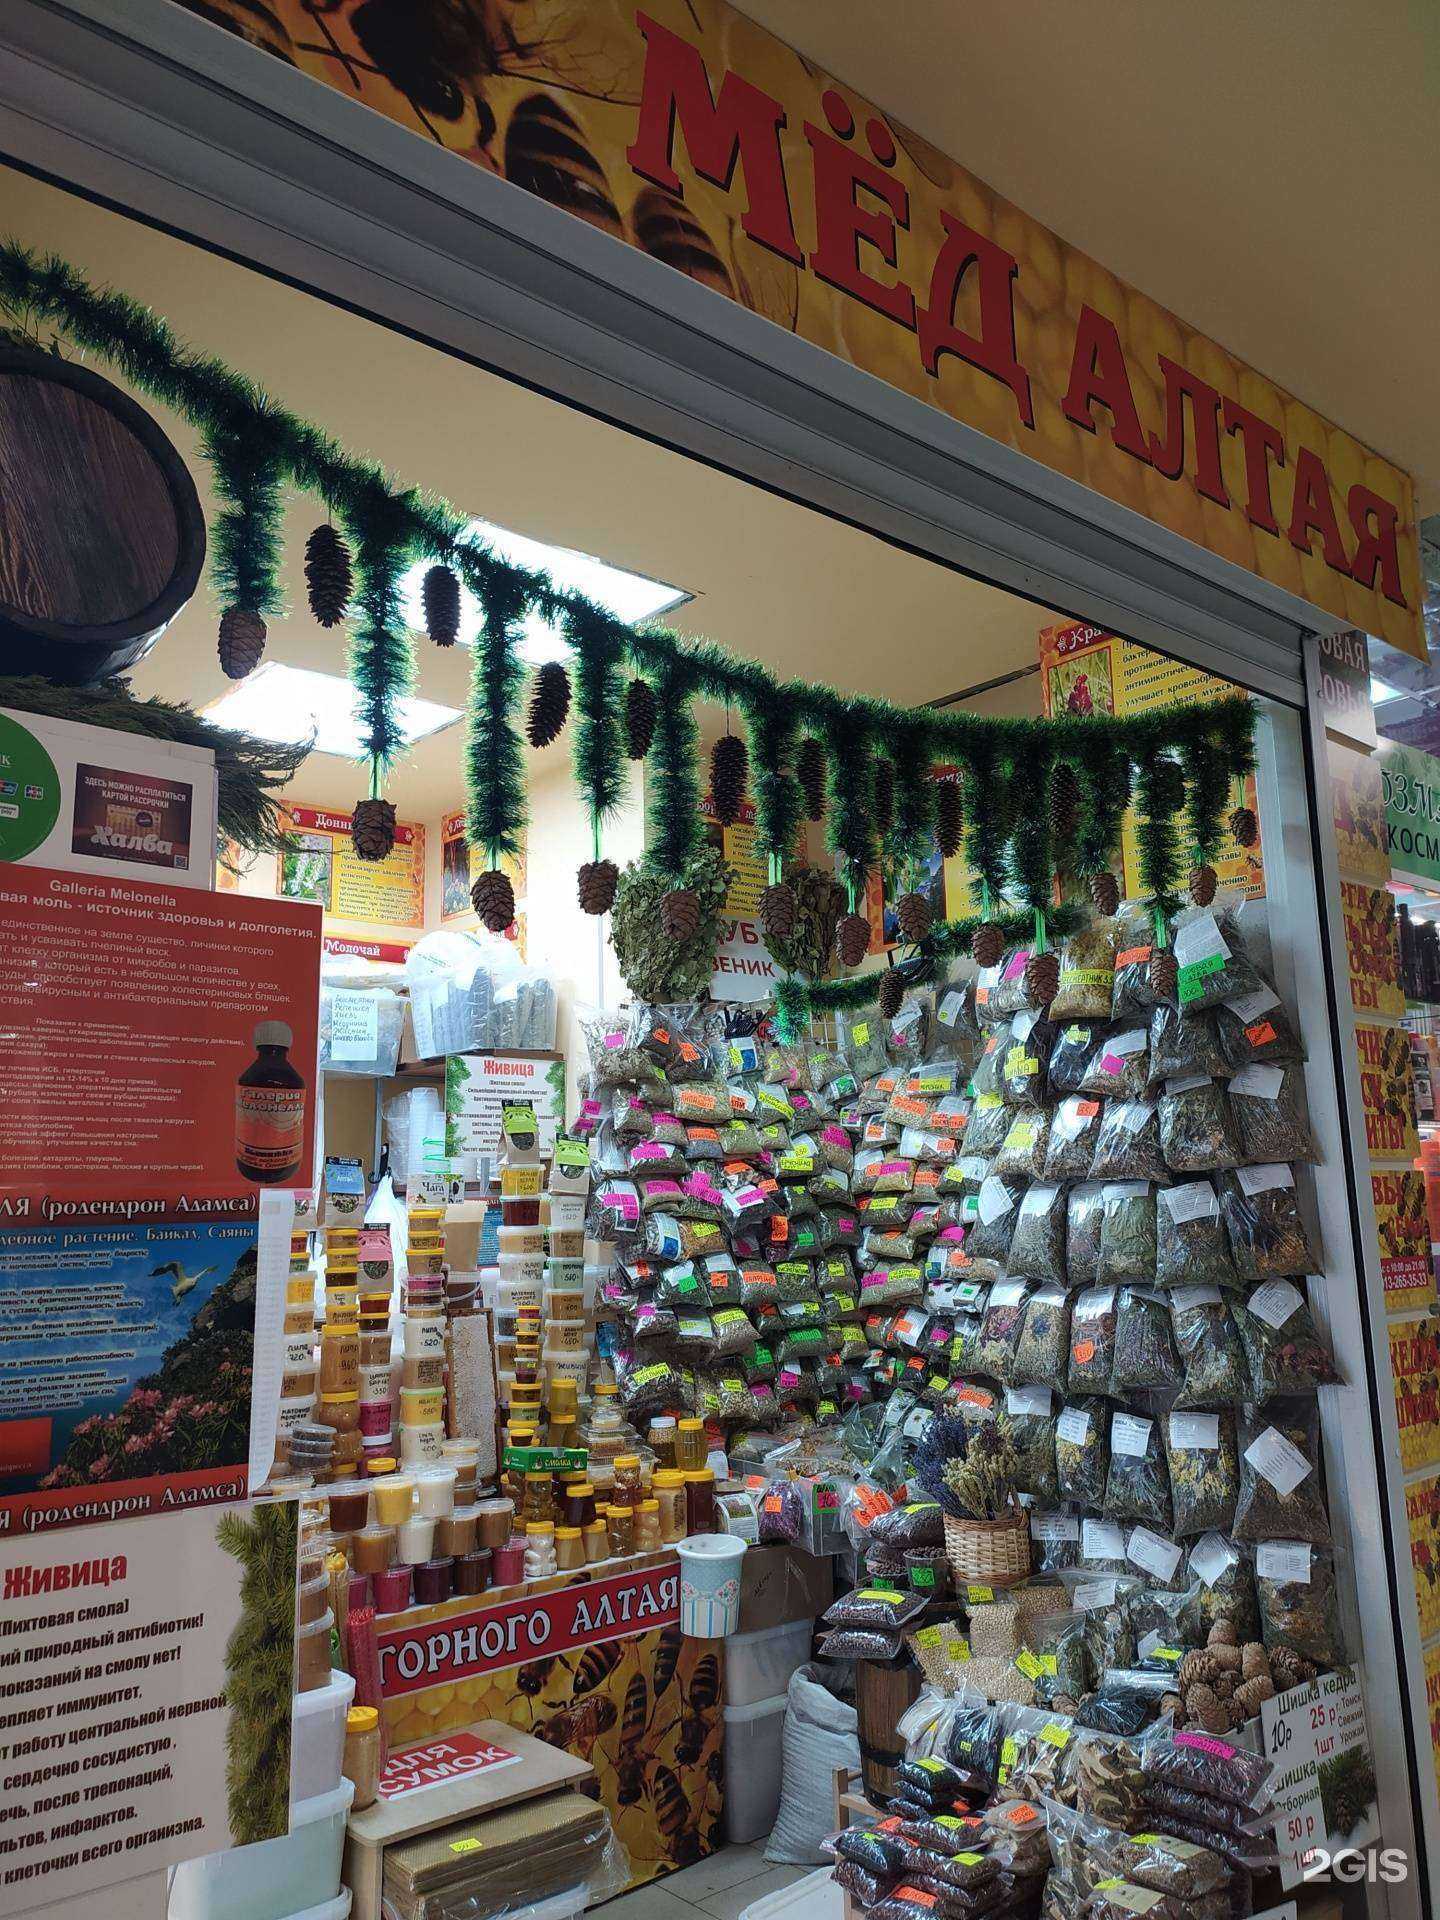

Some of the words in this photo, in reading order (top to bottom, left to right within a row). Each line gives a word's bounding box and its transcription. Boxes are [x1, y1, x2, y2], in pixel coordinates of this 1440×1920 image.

[626, 9, 1035, 430] МЁД
[1061, 304, 1407, 608] АЛТАЯ
[1069, 625, 1105, 650] Кра
[84, 777, 106, 787] ЗДЕСЬ
[108, 780, 134, 792] МОЖНО
[102, 790, 128, 801] КАРТОЙ
[91, 825, 173, 855] Халва
[49, 880, 106, 898] Galleria
[110, 887, 176, 907] Melonella
[32, 895, 72, 910] моль
[87, 903, 155, 920] источник
[157, 911, 224, 929] здоровья
[228, 919, 236, 928] и
[239, 921, 316, 939] долголетия.
[2, 920, 81, 936] единственное
[100, 931, 133, 941] земле
[136, 934, 188, 949] существо,
[190, 939, 230, 951] личинки
[232, 944, 274, 957] которого
[32, 936, 88, 948] усваивать
[91, 941, 144, 954] пчелиный
[326, 940, 380, 957] Молочай
[12, 946, 48, 958] клетку
[52, 949, 109, 963] организма
[112, 956, 124, 964] от
[127, 957, 176, 969] микробов
[33, 972, 107, 987] способствует
[110, 979, 168, 992] появлению
[172, 984, 252, 1000] холестериновых
[44, 961, 91, 974] который
[94, 966, 118, 976] есть
[121, 968, 127, 976] в
[130, 969, 189, 982] небольшом
[193, 975, 247, 988] количестве
[104, 992, 208, 1007] антибактериальным
[483, 1059, 534, 1078] Живица
[422, 1181, 445, 1197] Чага
[41, 1196, 166, 1221] (родендрон
[175, 1195, 256, 1216] Адамса)
[146, 1226, 200, 1242] Байкал,
[208, 1225, 254, 1237] Саяны
[22, 1496, 151, 1532] (родендрон
[160, 1475, 245, 1507] Адамса)
[2, 1554, 128, 1601] Живица
[77, 1599, 130, 1626] смола)
[23, 1632, 114, 1666] природный
[117, 1613, 204, 1642] антибиотик!
[378, 1609, 552, 1686] ГОРНОГО
[570, 1575, 679, 1635] АЛТАЯ
[84, 1663, 102, 1680] на
[105, 1654, 150, 1678] смолу
[152, 1644, 182, 1667] нет!
[56, 1685, 143, 1718] иммунитет,
[1277, 1686, 1321, 1716] Шишка
[1323, 1669, 1357, 1695] кедра
[1341, 1693, 1362, 1709] Томск
[11, 1733, 66, 1762] работу
[68, 1706, 166, 1746] центральной
[168, 1693, 227, 1723] нервной
[1310, 1704, 1326, 1730] 25
[1328, 1706, 1337, 1723] р
[1314, 1735, 1336, 1756] 1шт
[3, 1759, 80, 1791] сердечно
[378, 1745, 508, 1794] СУМОК
[33, 1789, 81, 1814] после
[83, 1763, 174, 1803] трепонаций,
[50, 1804, 138, 1842] инфарктов.
[1288, 1820, 1302, 1842] 50
[1306, 1815, 1315, 1836] р
[3, 1853, 79, 1886] клеточки
[81, 1839, 123, 1864] всего
[125, 1815, 206, 1852] организма.
